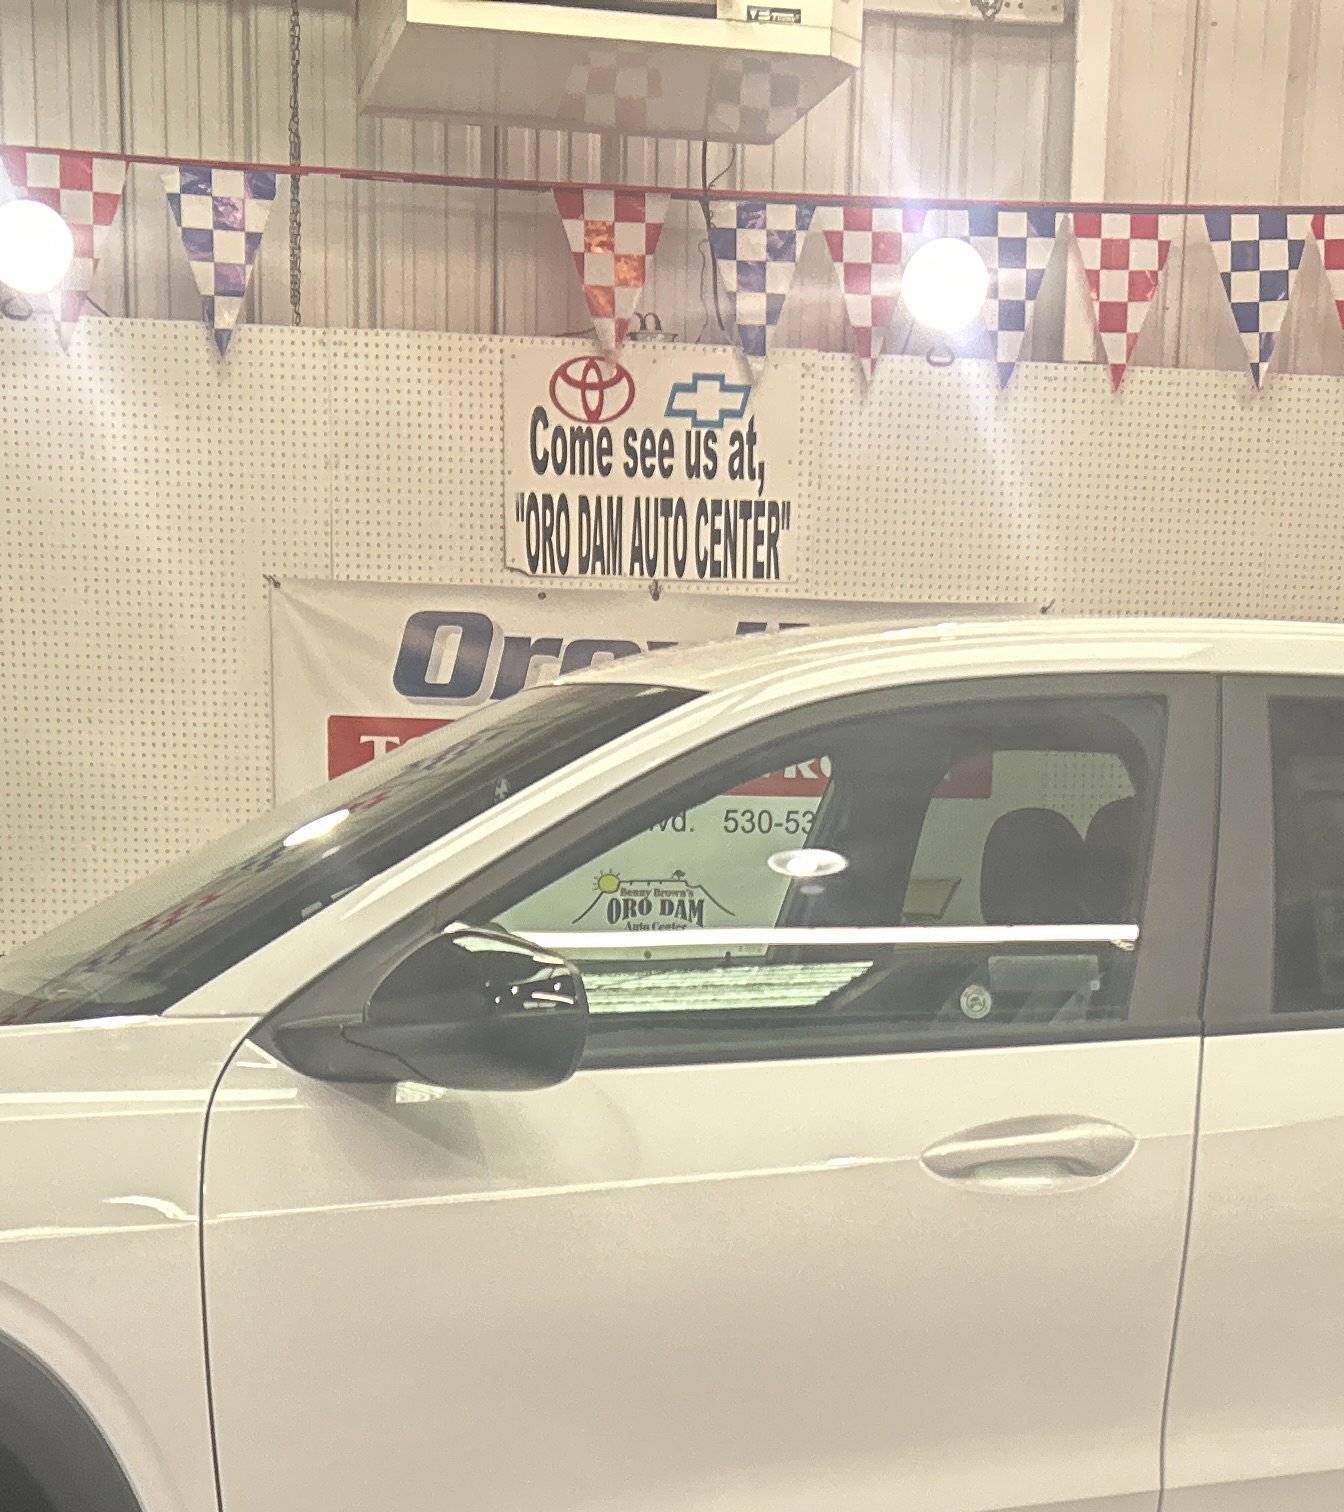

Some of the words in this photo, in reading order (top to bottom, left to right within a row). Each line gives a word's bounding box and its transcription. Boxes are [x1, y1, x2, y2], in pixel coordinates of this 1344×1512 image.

[529, 405, 613, 477] Come
[623, 427, 674, 479] see
[685, 428, 718, 480] us
[728, 414, 765, 497] at,
[515, 491, 571, 576] "ORO
[578, 494, 623, 577] DAM
[629, 495, 688, 579] AUTO
[695, 496, 792, 580] CENTER"
[619, 887, 652, 899] Benny
[653, 887, 694, 898] Brown's
[607, 897, 653, 924] ORO
[659, 898, 705, 928] DAM
[624, 921, 650, 932] Auto
[651, 921, 688, 932] Center
